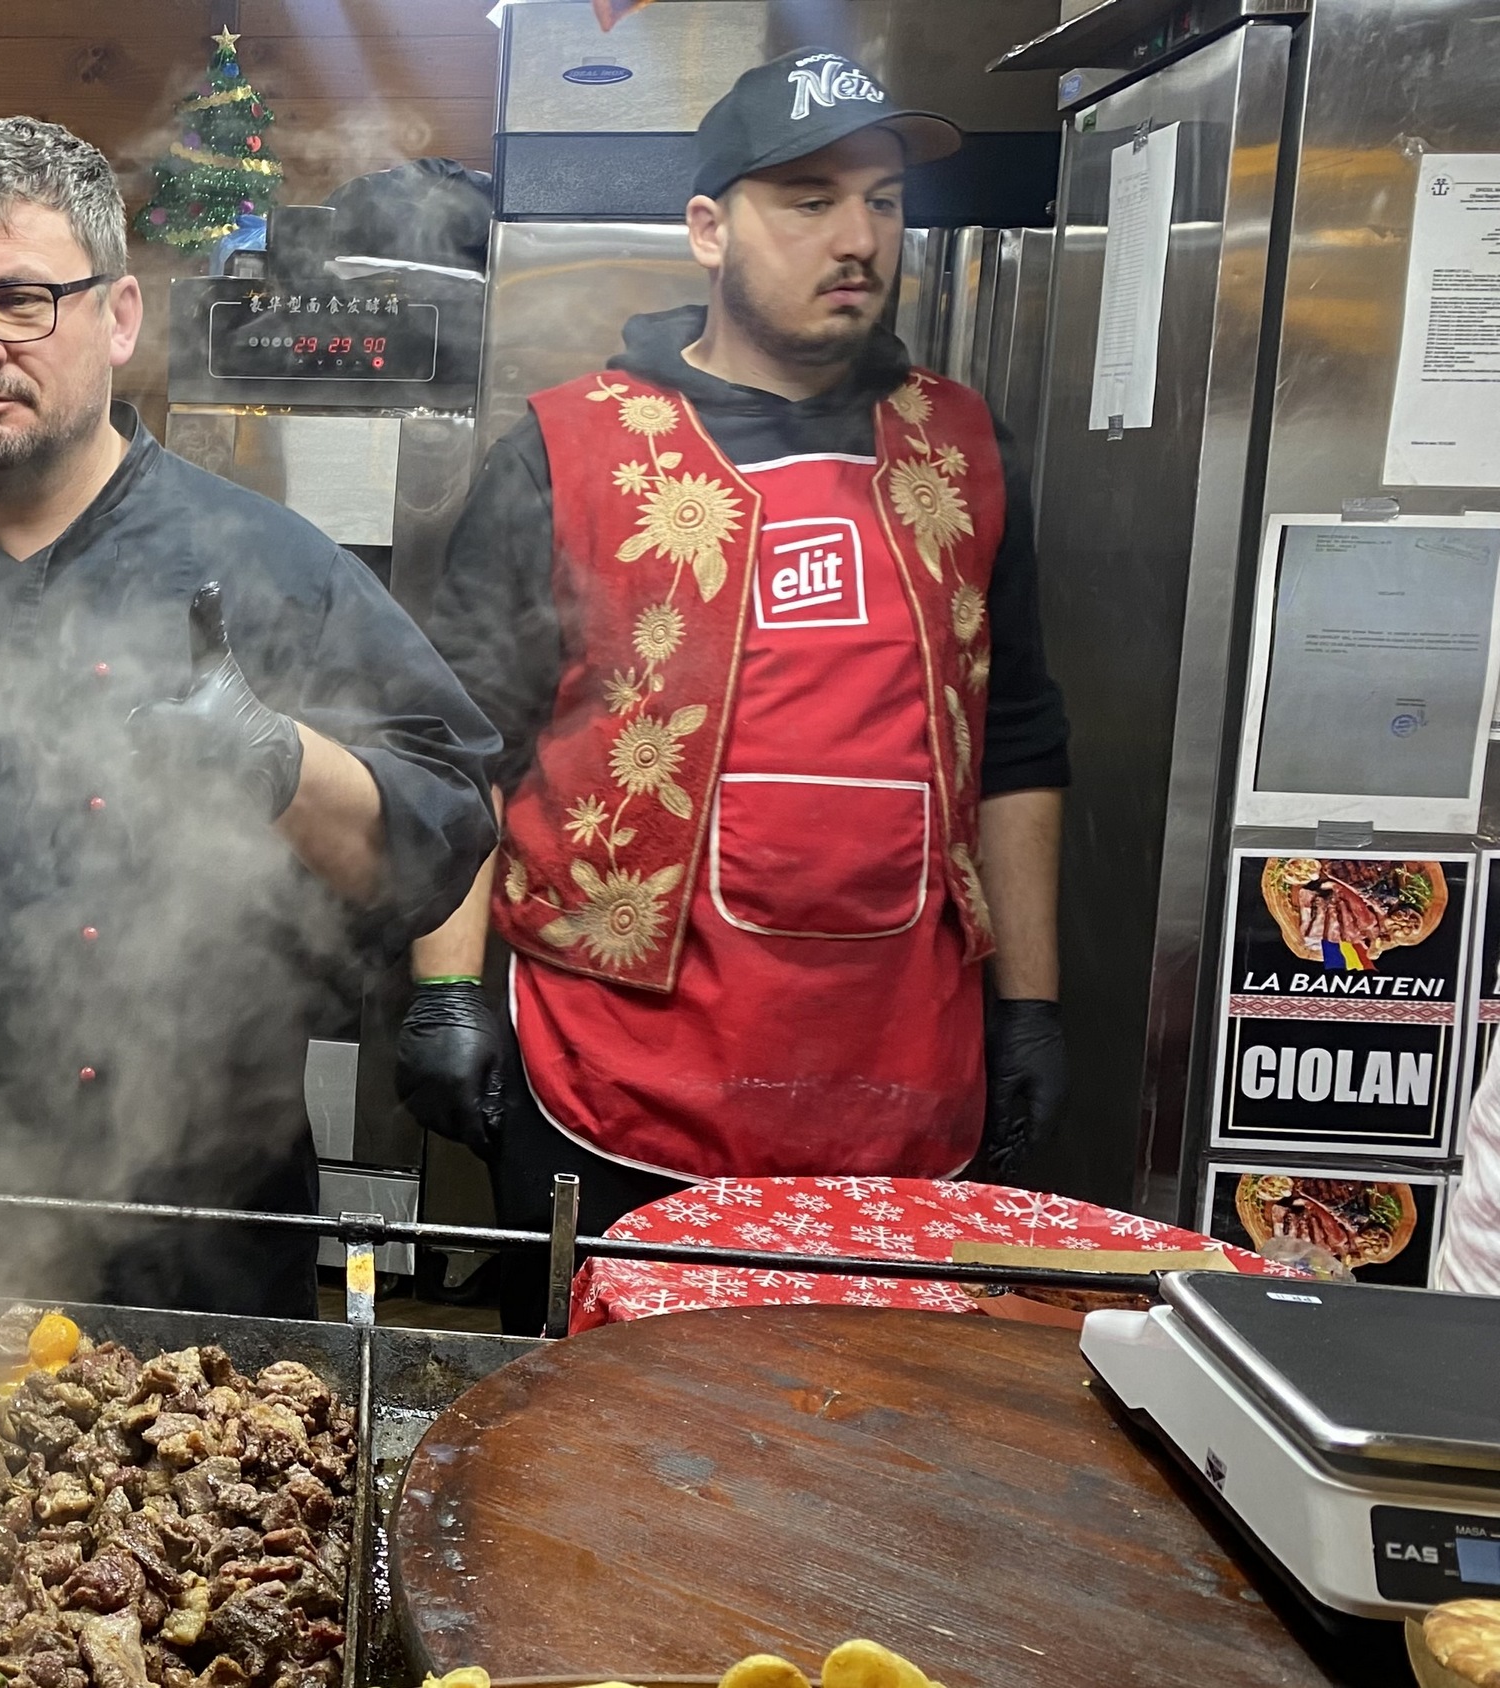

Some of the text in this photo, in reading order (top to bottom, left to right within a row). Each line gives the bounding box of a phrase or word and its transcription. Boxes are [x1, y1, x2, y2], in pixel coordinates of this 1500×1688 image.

[788, 60, 885, 120] Nets
[294, 336, 387, 353] 29 29 90
[771, 548, 843, 600] elit
[1242, 971, 1446, 997] LA BANATENI
[1240, 1045, 1434, 1107] CIOLAN
[1455, 1525, 1487, 1537] MASA
[1385, 1541, 1440, 1564] CAS
